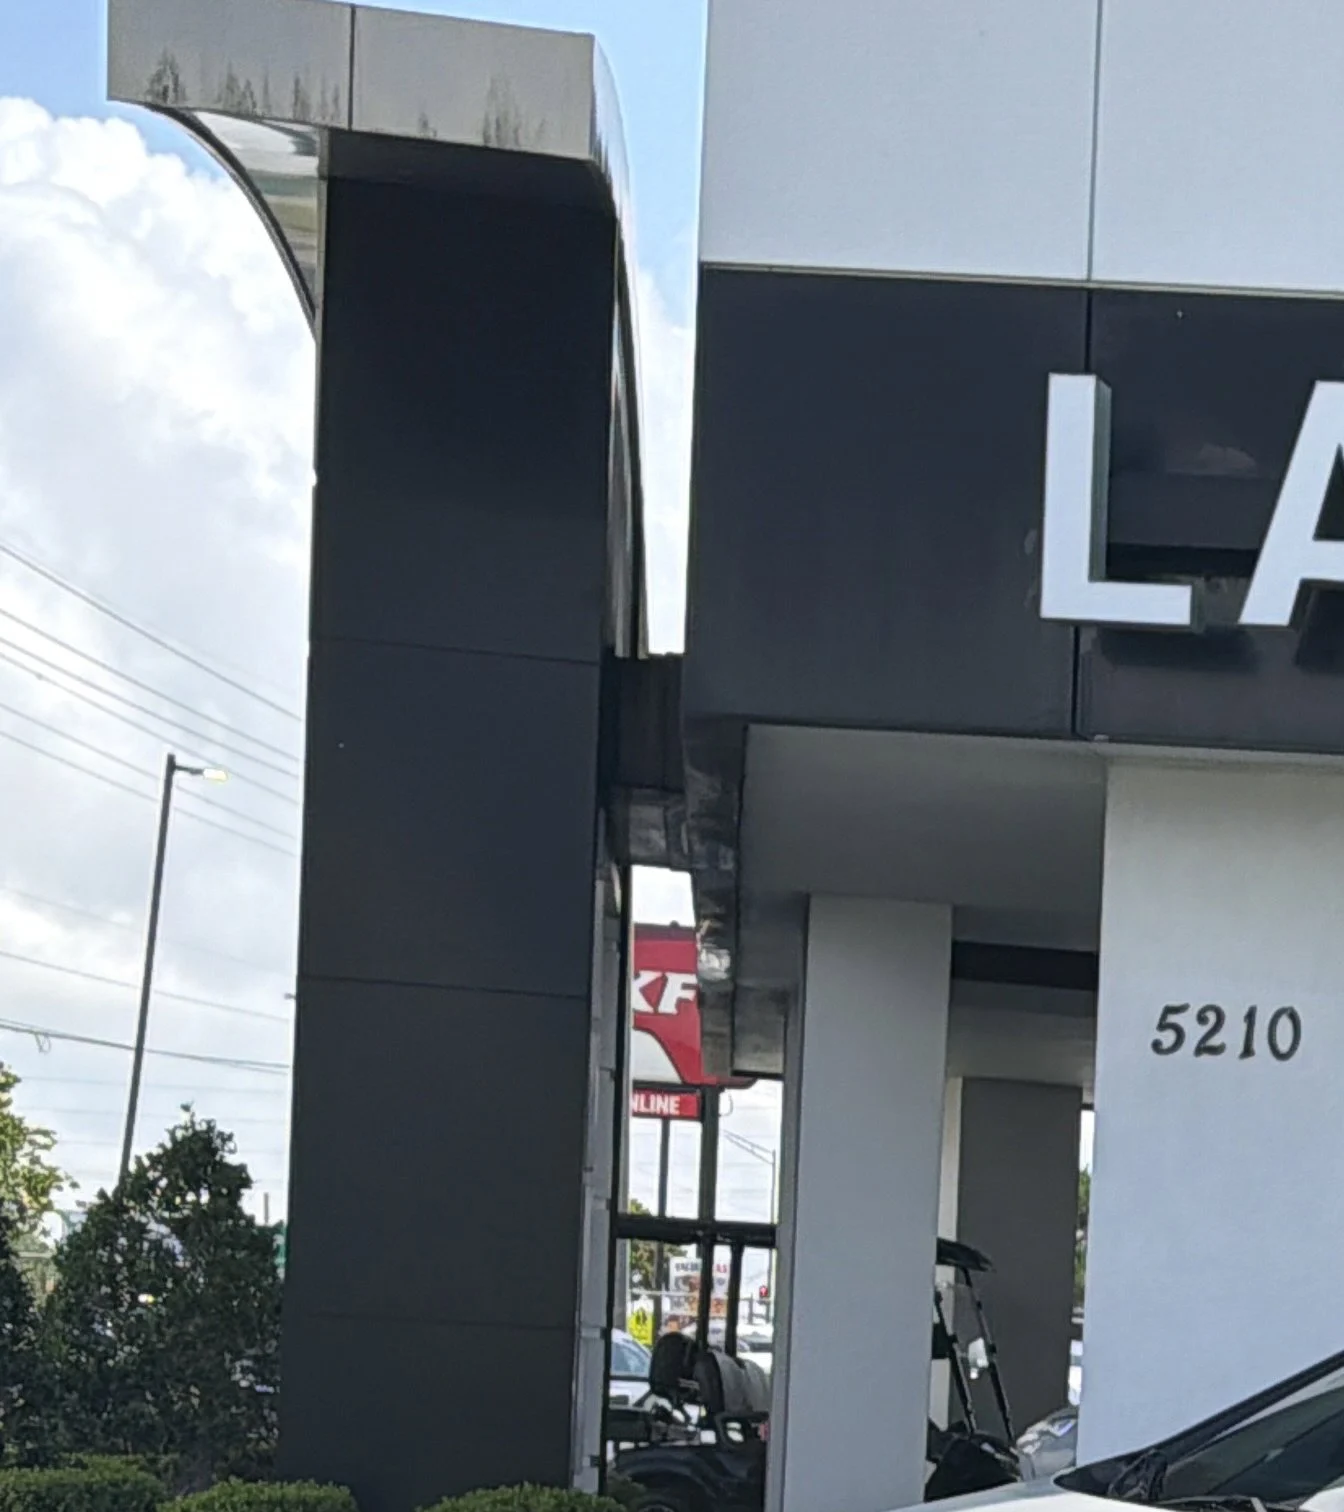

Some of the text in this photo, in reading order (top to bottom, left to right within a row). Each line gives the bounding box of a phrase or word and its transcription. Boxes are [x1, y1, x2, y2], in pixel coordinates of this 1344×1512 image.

[631, 970, 698, 1015] KF
[1151, 1002, 1302, 1062] 5210
[631, 1092, 681, 1116] NLINE
